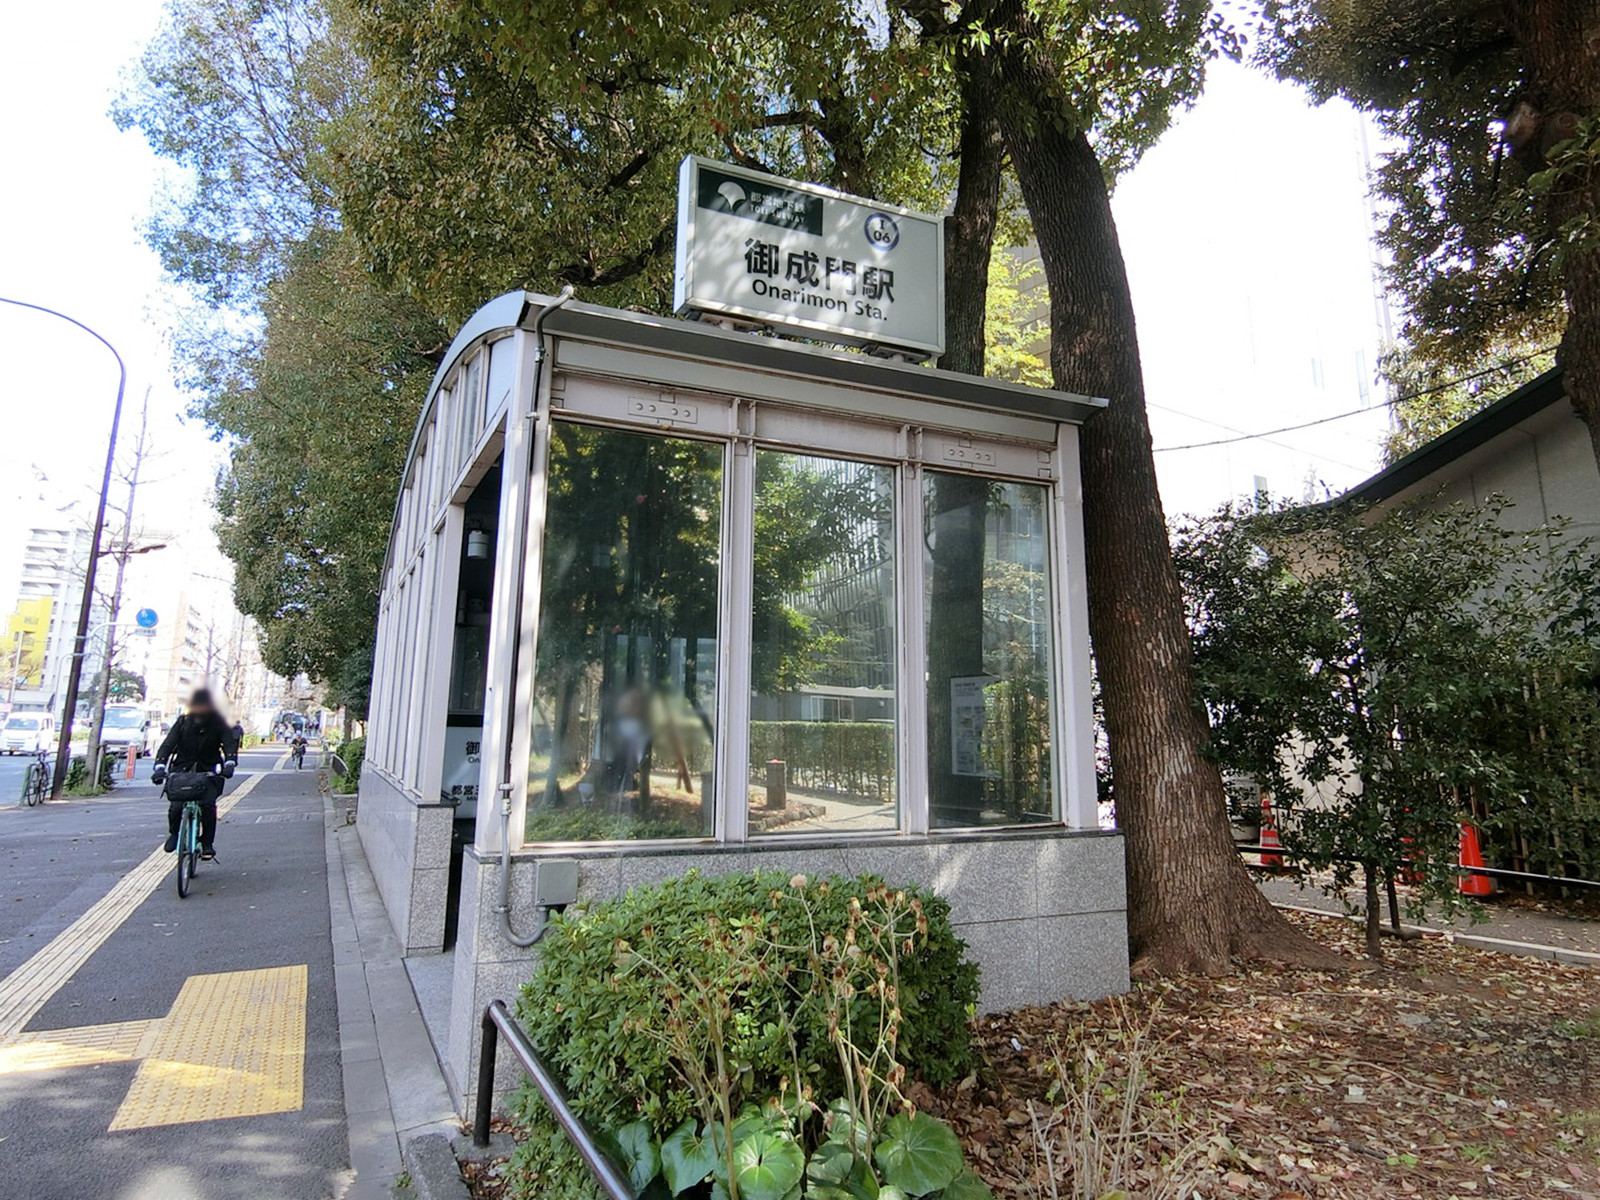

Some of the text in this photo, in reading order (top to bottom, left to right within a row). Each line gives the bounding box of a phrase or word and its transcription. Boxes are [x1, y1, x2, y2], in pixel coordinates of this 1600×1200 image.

[873, 230, 891, 244] 06
[744, 237, 895, 304] 御成門駅
[752, 278, 888, 321] Onarimon Sta.
